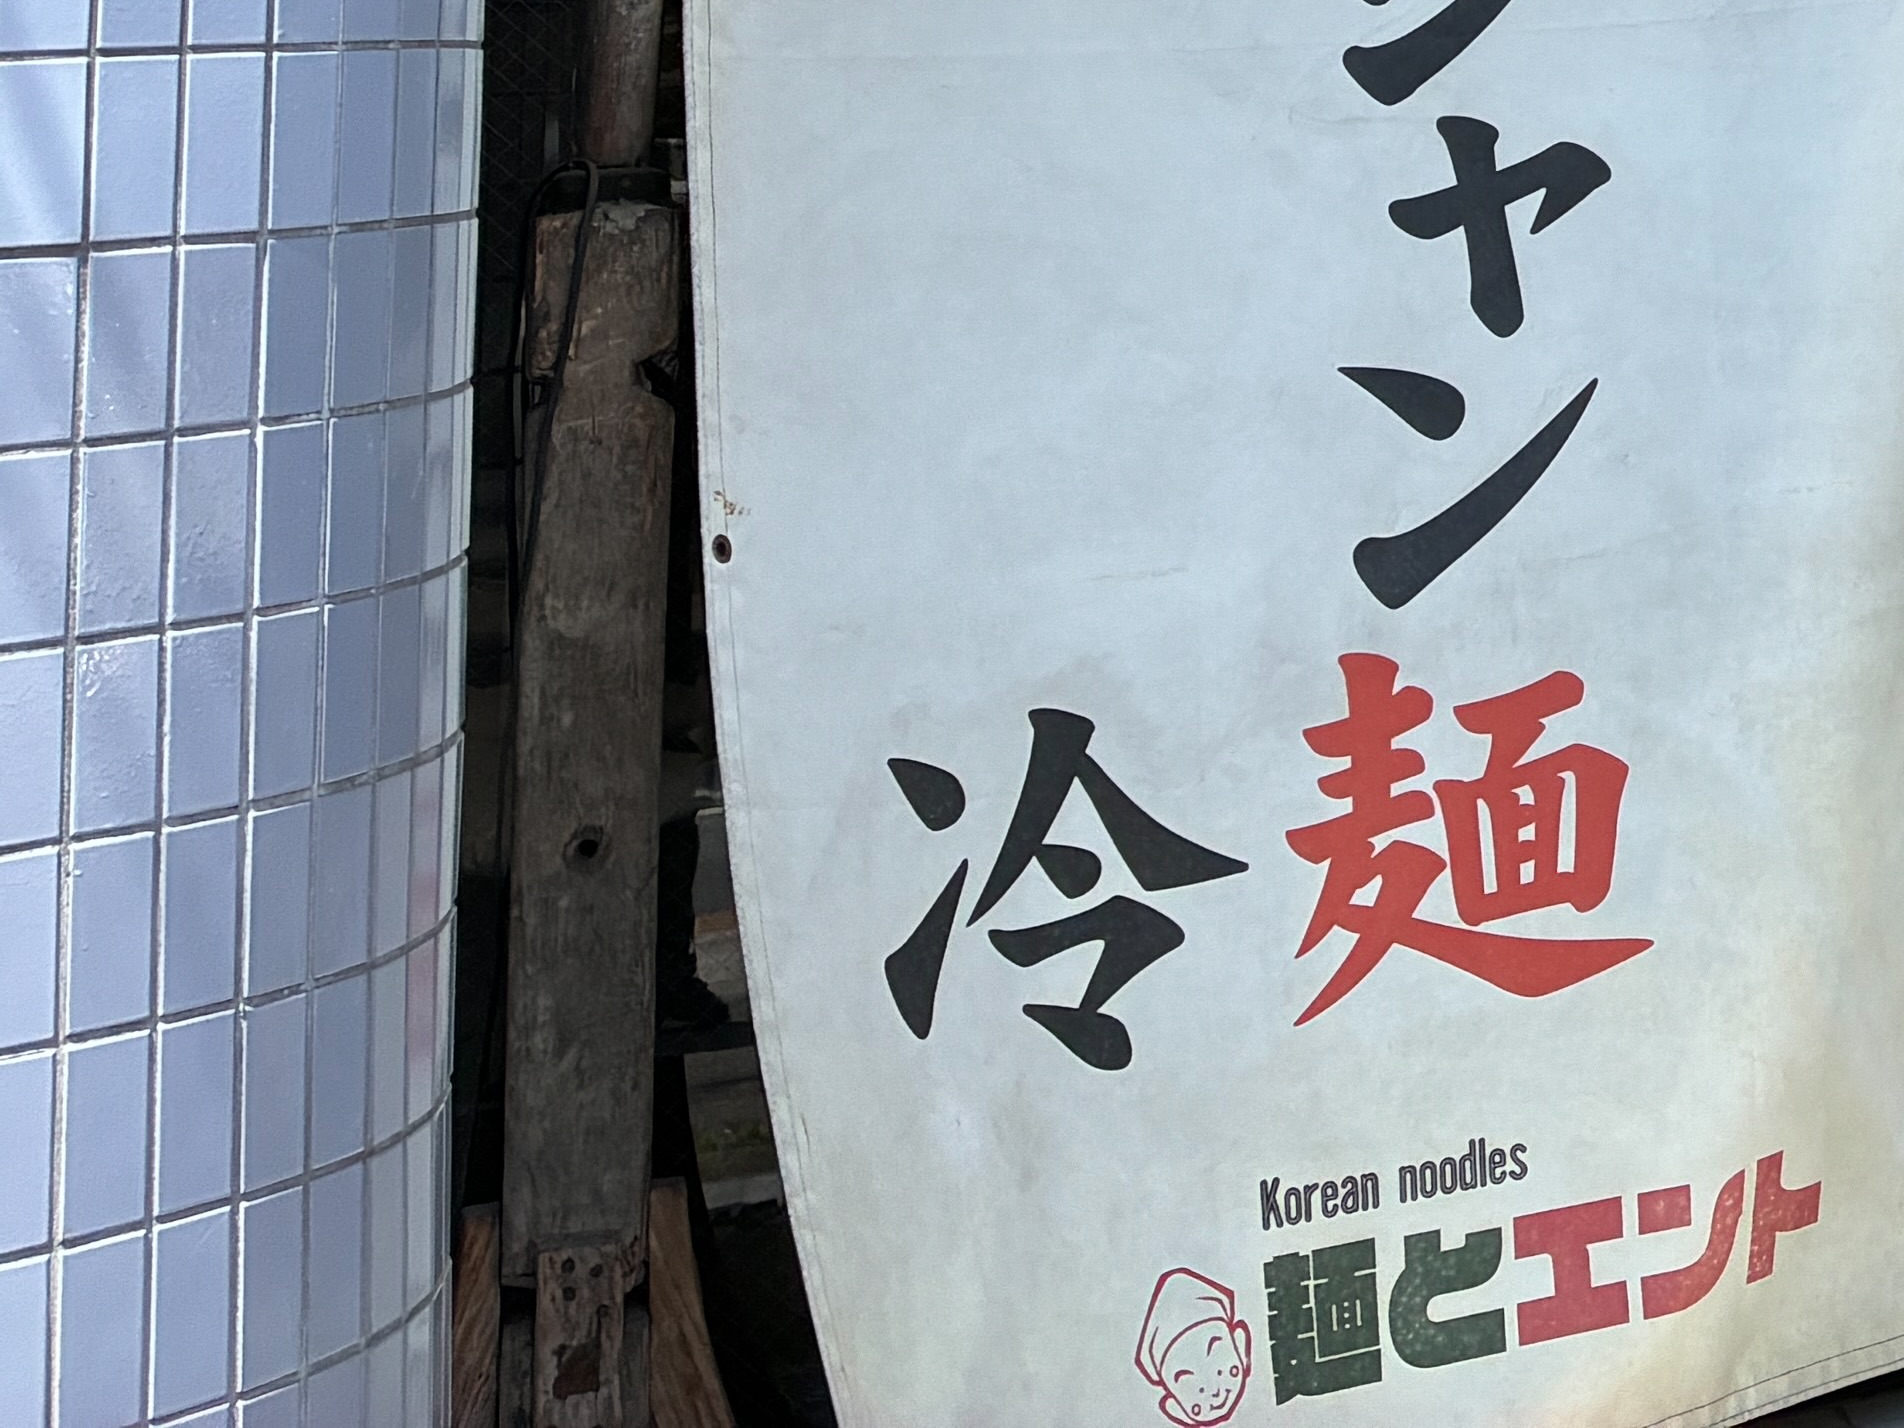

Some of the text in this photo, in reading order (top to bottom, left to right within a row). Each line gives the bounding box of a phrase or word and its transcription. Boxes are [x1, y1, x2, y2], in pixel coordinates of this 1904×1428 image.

[1259, 1137, 1529, 1232] Korean noodles
[1262, 1149, 1823, 1407] 麺とエント
